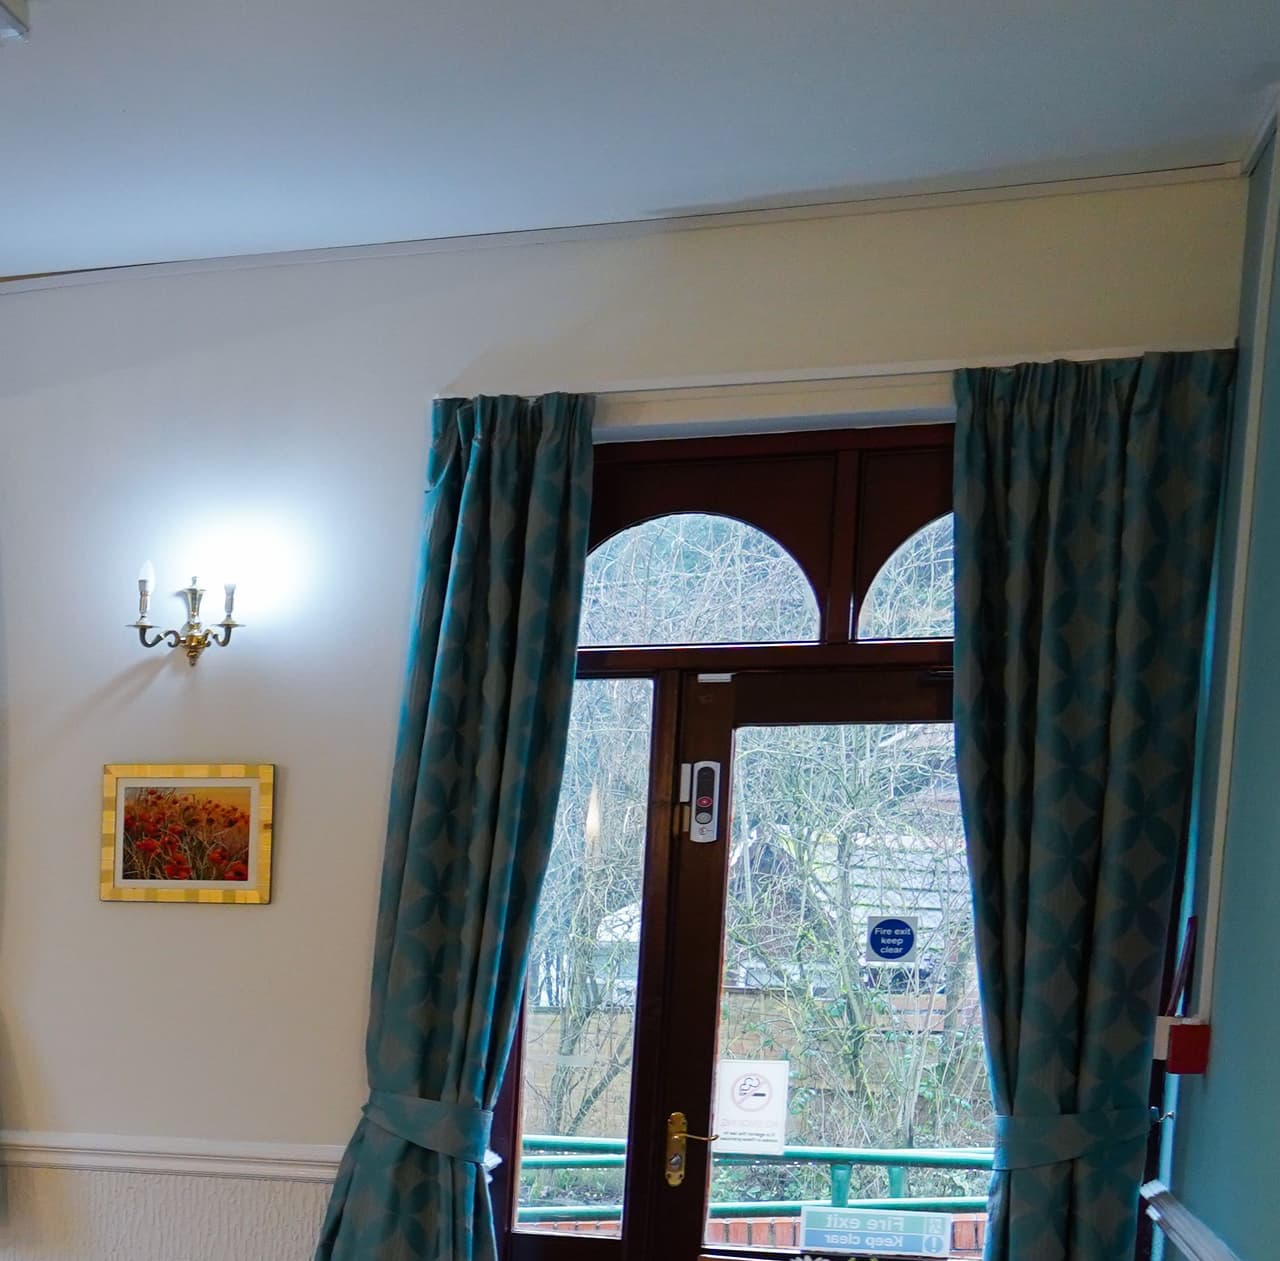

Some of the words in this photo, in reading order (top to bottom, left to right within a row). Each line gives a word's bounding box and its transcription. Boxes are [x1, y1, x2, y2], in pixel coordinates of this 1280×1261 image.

[874, 927, 892, 936] Fire
[893, 927, 911, 936] exit
[880, 936, 904, 946] keep
[880, 945, 905, 954] clear
